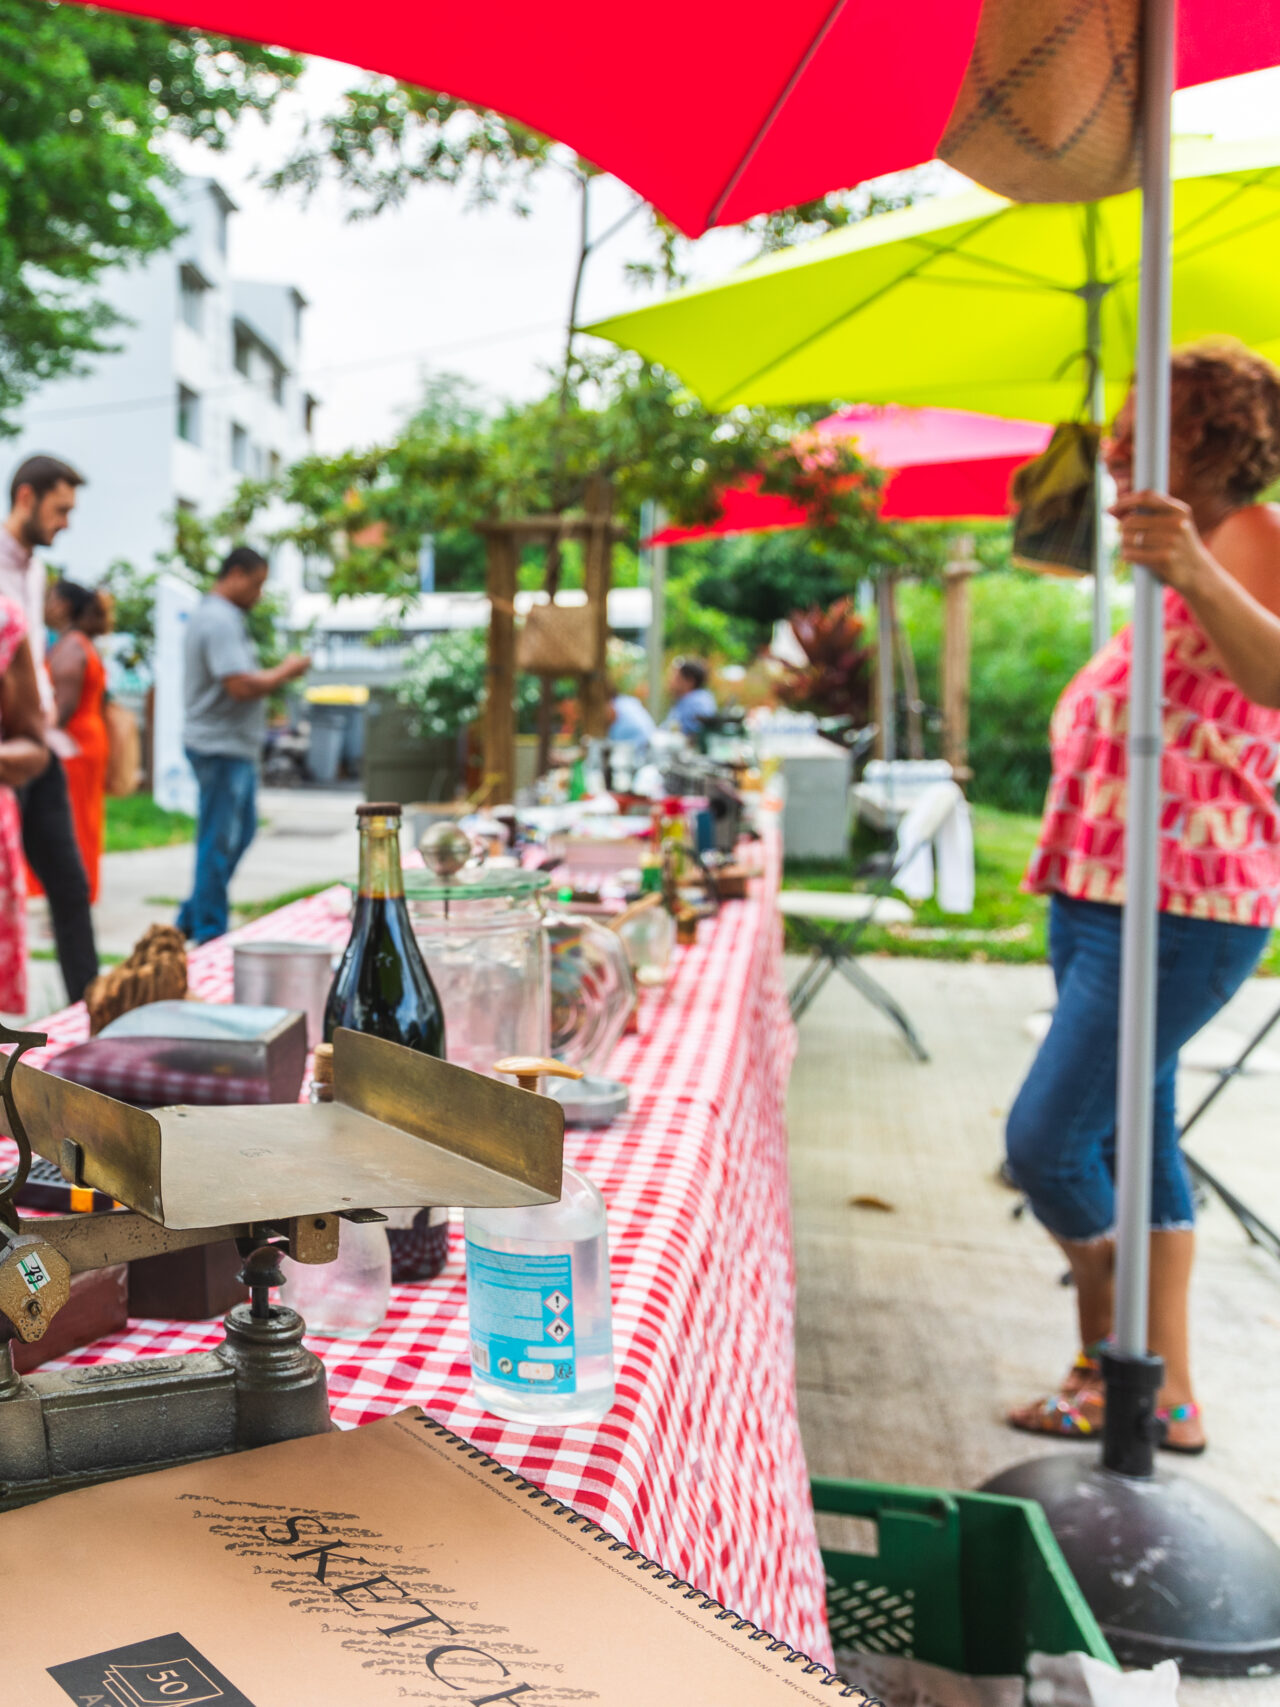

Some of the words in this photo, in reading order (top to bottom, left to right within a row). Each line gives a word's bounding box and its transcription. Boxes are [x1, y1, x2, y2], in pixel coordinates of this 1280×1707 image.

[521, 1508, 587, 1552] MICROPERFORATIE
[592, 1555, 669, 1606] MICROPERFORATED
[673, 1608, 774, 1674] MICRO-PERFORAZIONE
[781, 1679, 831, 1707] MICROPE
[146, 1669, 189, 1695] 50
[78, 1694, 112, 1707] A
